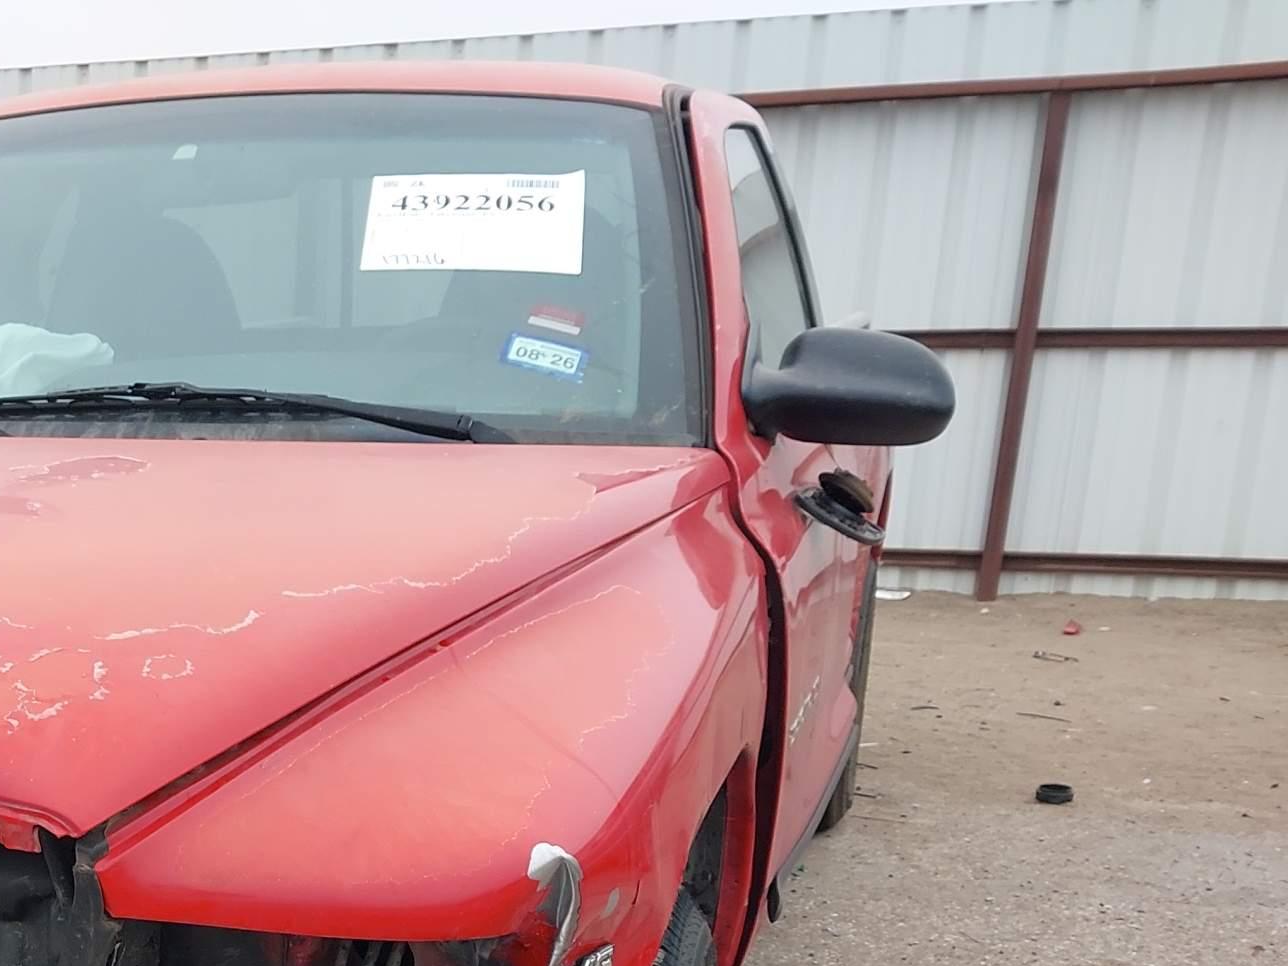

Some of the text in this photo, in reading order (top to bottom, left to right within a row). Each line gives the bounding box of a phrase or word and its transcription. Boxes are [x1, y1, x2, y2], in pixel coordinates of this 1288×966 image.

[391, 194, 556, 213] 43922056
[515, 346, 576, 370] 08 26
